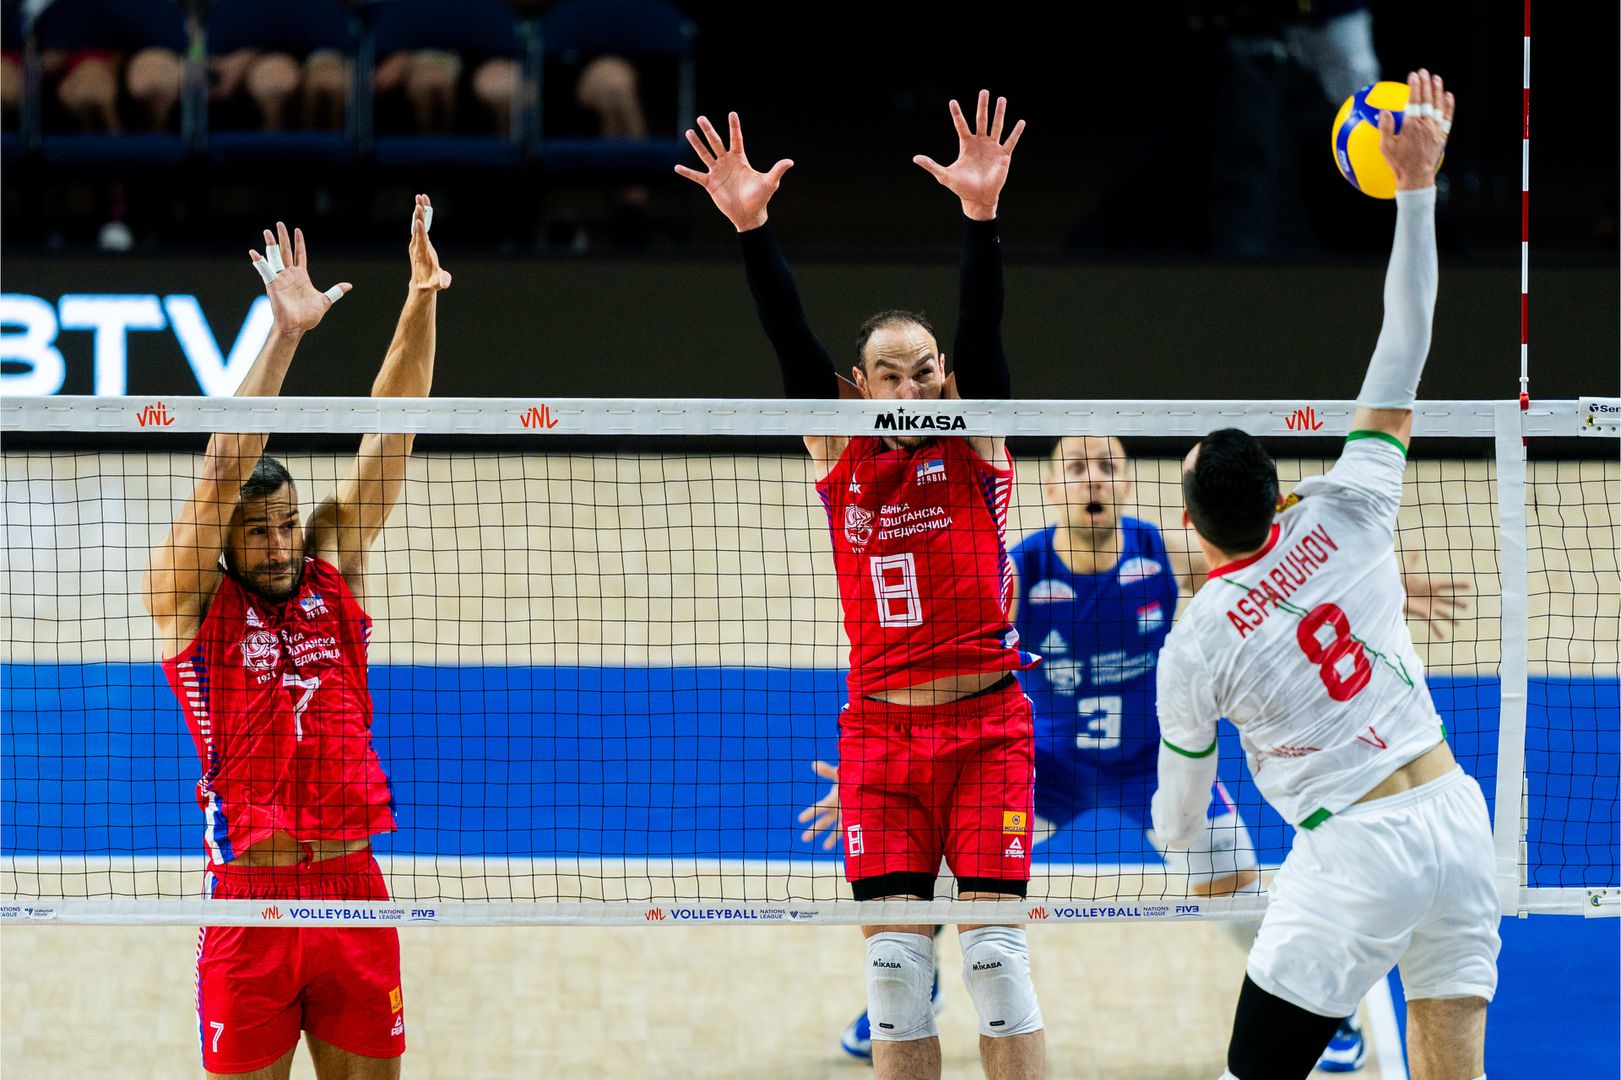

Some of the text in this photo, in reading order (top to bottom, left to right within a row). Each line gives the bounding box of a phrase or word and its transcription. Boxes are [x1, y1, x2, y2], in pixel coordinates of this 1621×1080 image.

[136, 402, 175, 427] VNL
[520, 403, 559, 429] VNL
[874, 409, 967, 431] MIKASA
[1285, 406, 1324, 431] VNL
[880, 506, 945, 527] ПОШТАНСКА
[869, 552, 923, 628] 8
[1226, 523, 1338, 638] ASPARUHOV
[1296, 602, 1371, 702] 8
[282, 672, 321, 741] 7
[1076, 695, 1123, 750] 3
[847, 824, 864, 857] 8
[262, 905, 377, 920] VNL VOLLEYBALL
[411, 909, 436, 918] FIVB
[645, 907, 758, 921] VNL VOLLEYBALL
[1027, 906, 1141, 920] VNL VOLLEYBALL
[1175, 905, 1200, 914] FIVB
[873, 958, 902, 969] MIKASA
[972, 961, 1003, 972] MIKASA
[210, 1021, 225, 1053] 7
